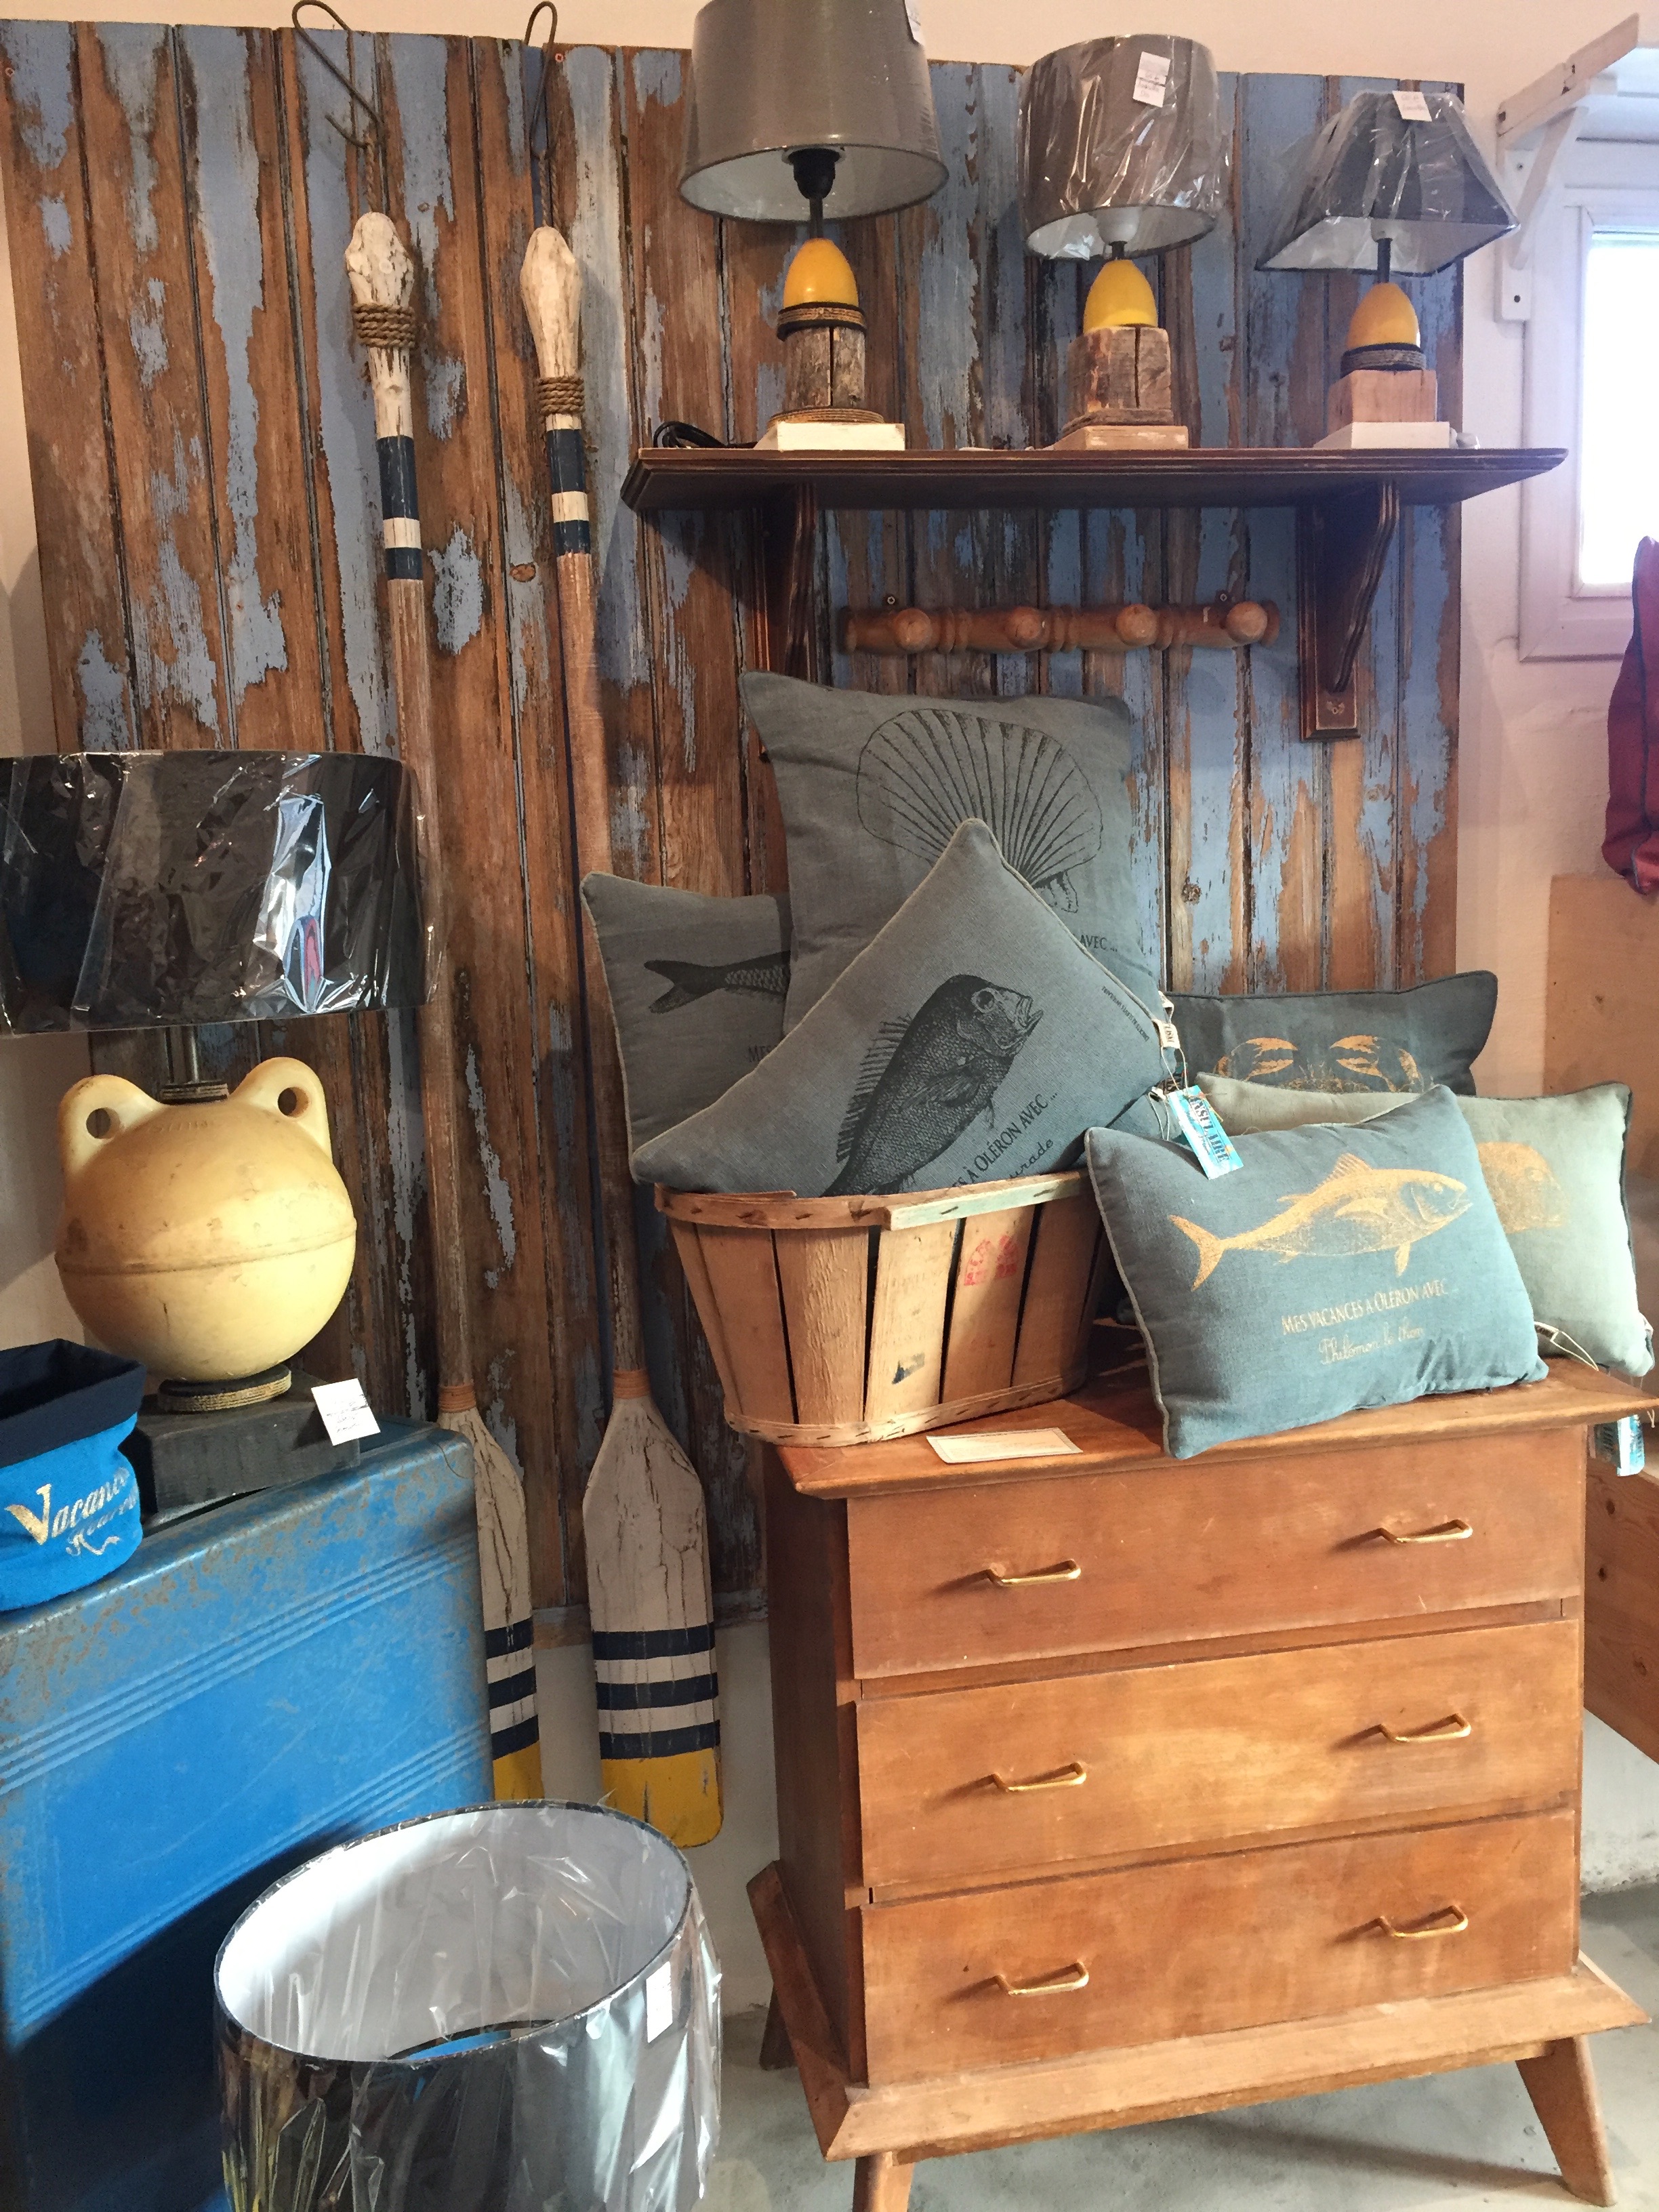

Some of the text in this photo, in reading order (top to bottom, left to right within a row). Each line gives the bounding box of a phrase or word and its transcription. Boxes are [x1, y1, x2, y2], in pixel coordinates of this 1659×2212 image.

[973, 1122, 1022, 1172] OLÉRON
[1282, 1315, 1307, 1335] MES
[1308, 1299, 1364, 1329] VACANCES
